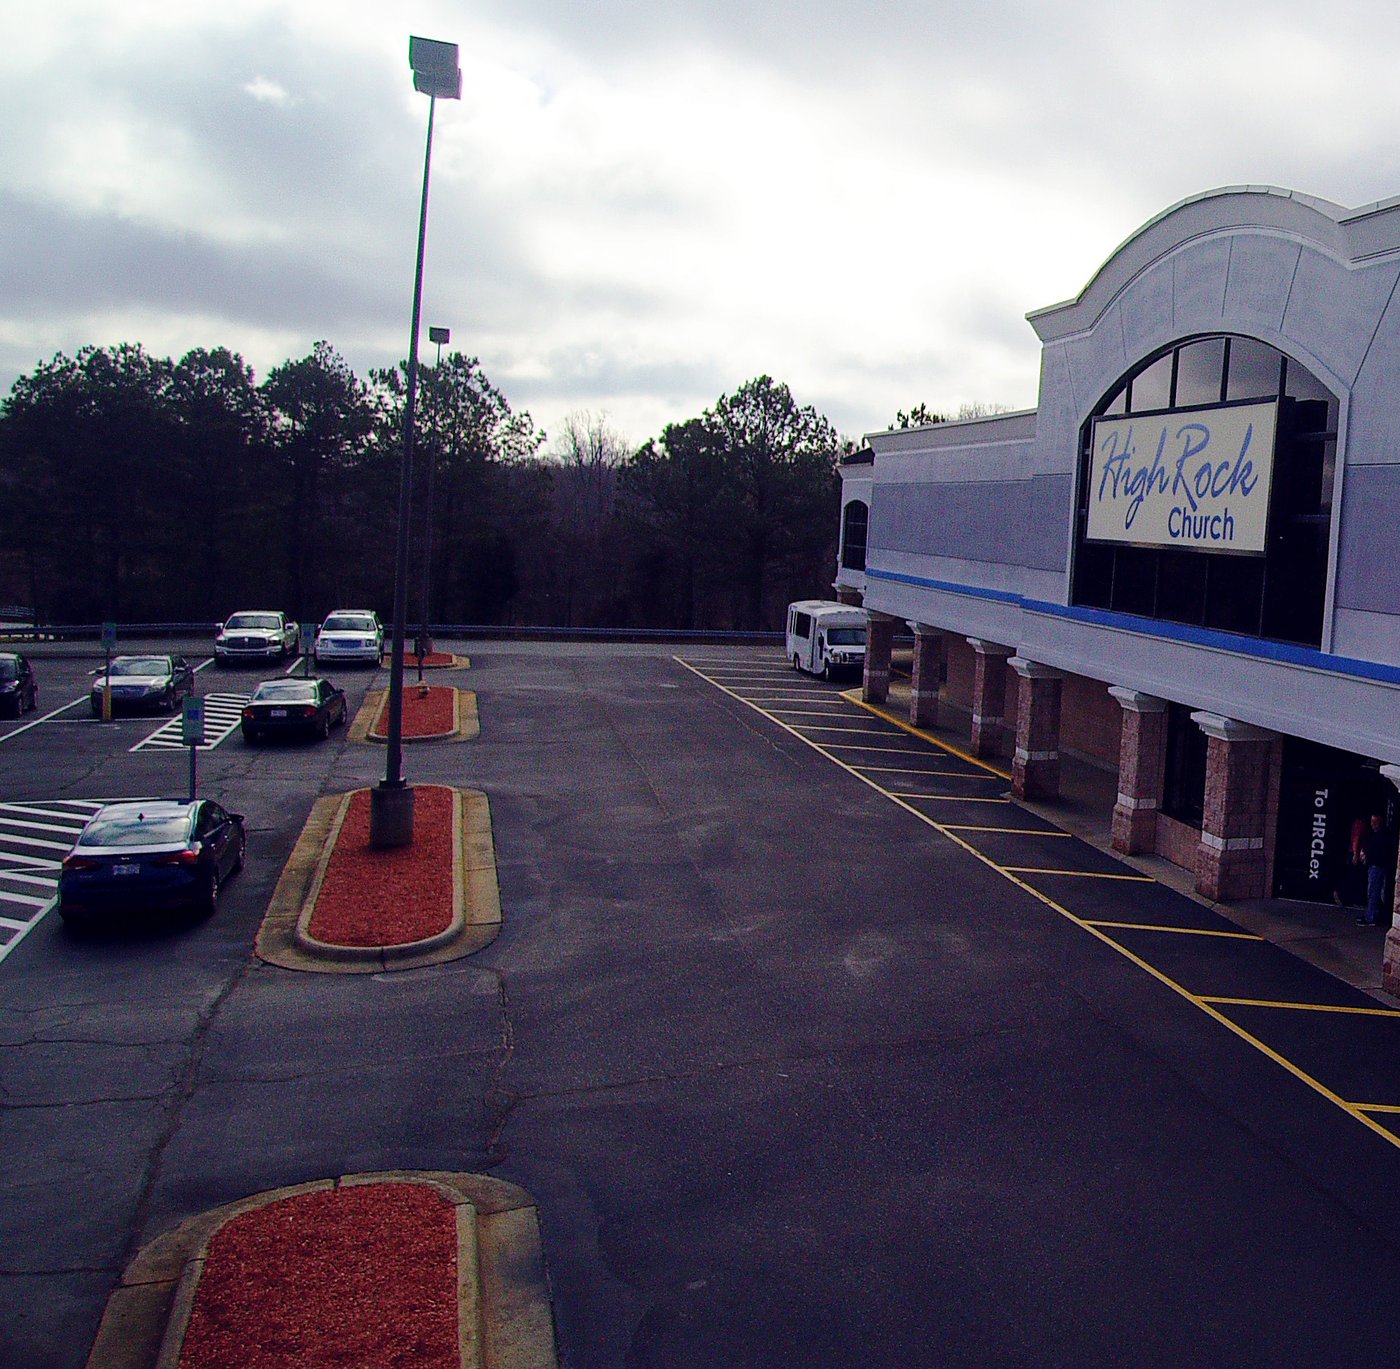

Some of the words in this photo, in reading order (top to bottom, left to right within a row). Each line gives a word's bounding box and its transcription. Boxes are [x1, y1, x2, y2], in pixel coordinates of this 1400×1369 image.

[1098, 425, 1170, 530] High
[1172, 422, 1259, 512] Rock
[1168, 506, 1234, 540] Church
[1314, 788, 1328, 807] To
[1308, 813, 1327, 879] HRCLex
